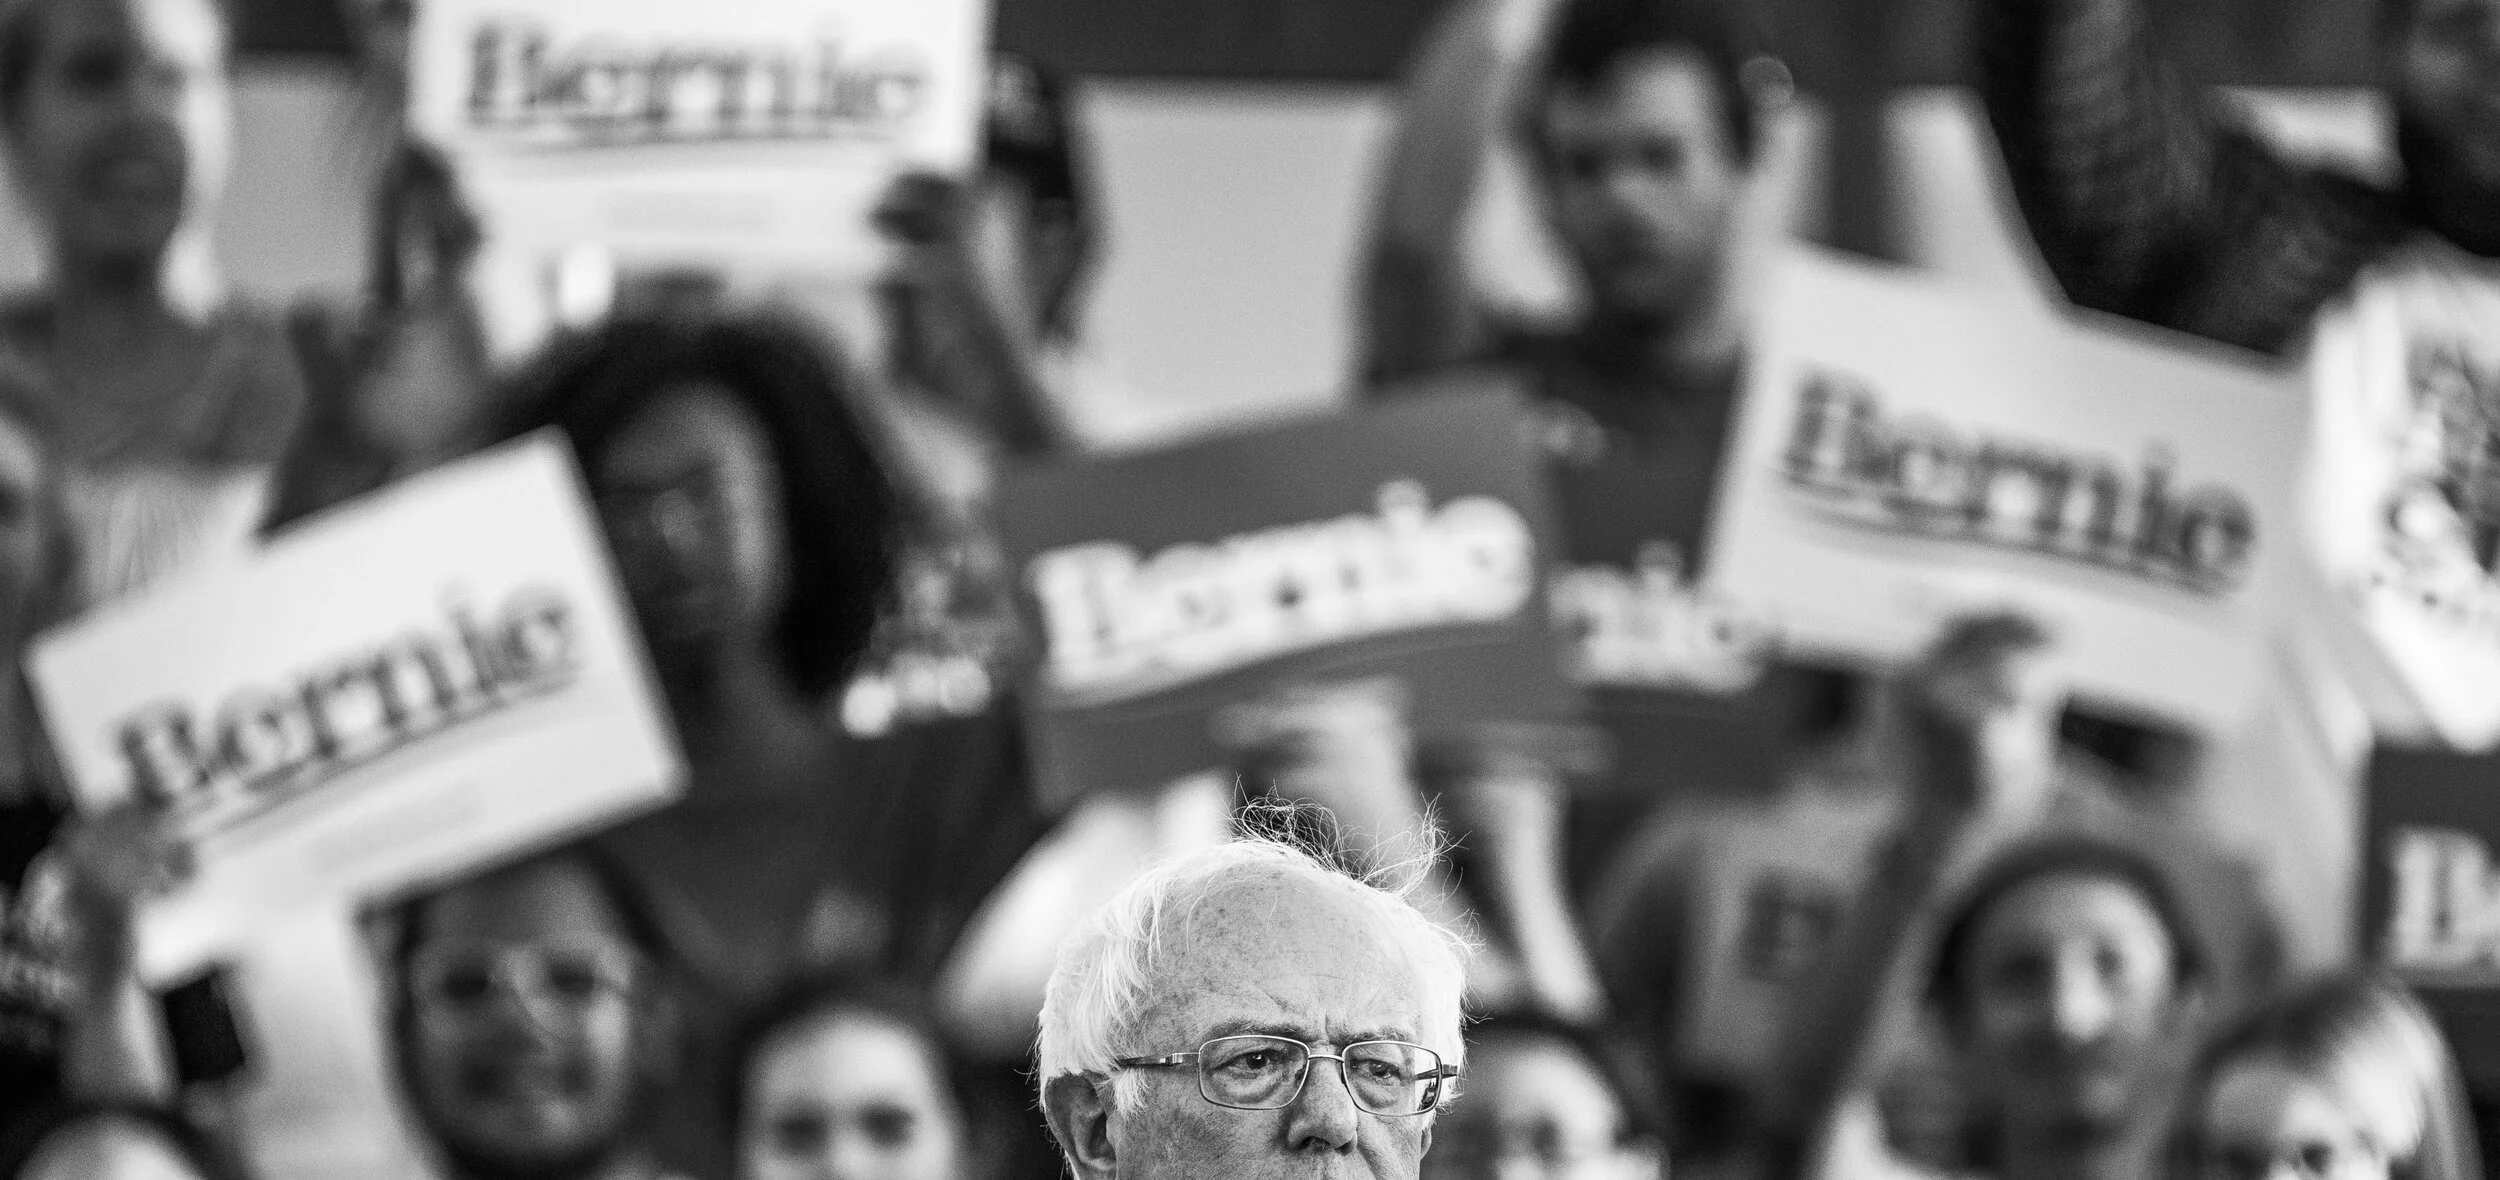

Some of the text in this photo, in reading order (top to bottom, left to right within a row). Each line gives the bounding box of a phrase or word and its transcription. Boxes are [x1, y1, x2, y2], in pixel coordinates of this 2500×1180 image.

[461, 12, 932, 126] Bernie
[1028, 480, 1536, 676] Bernie
[1785, 370, 2257, 589] Bernie
[113, 577, 578, 806] Bernie
